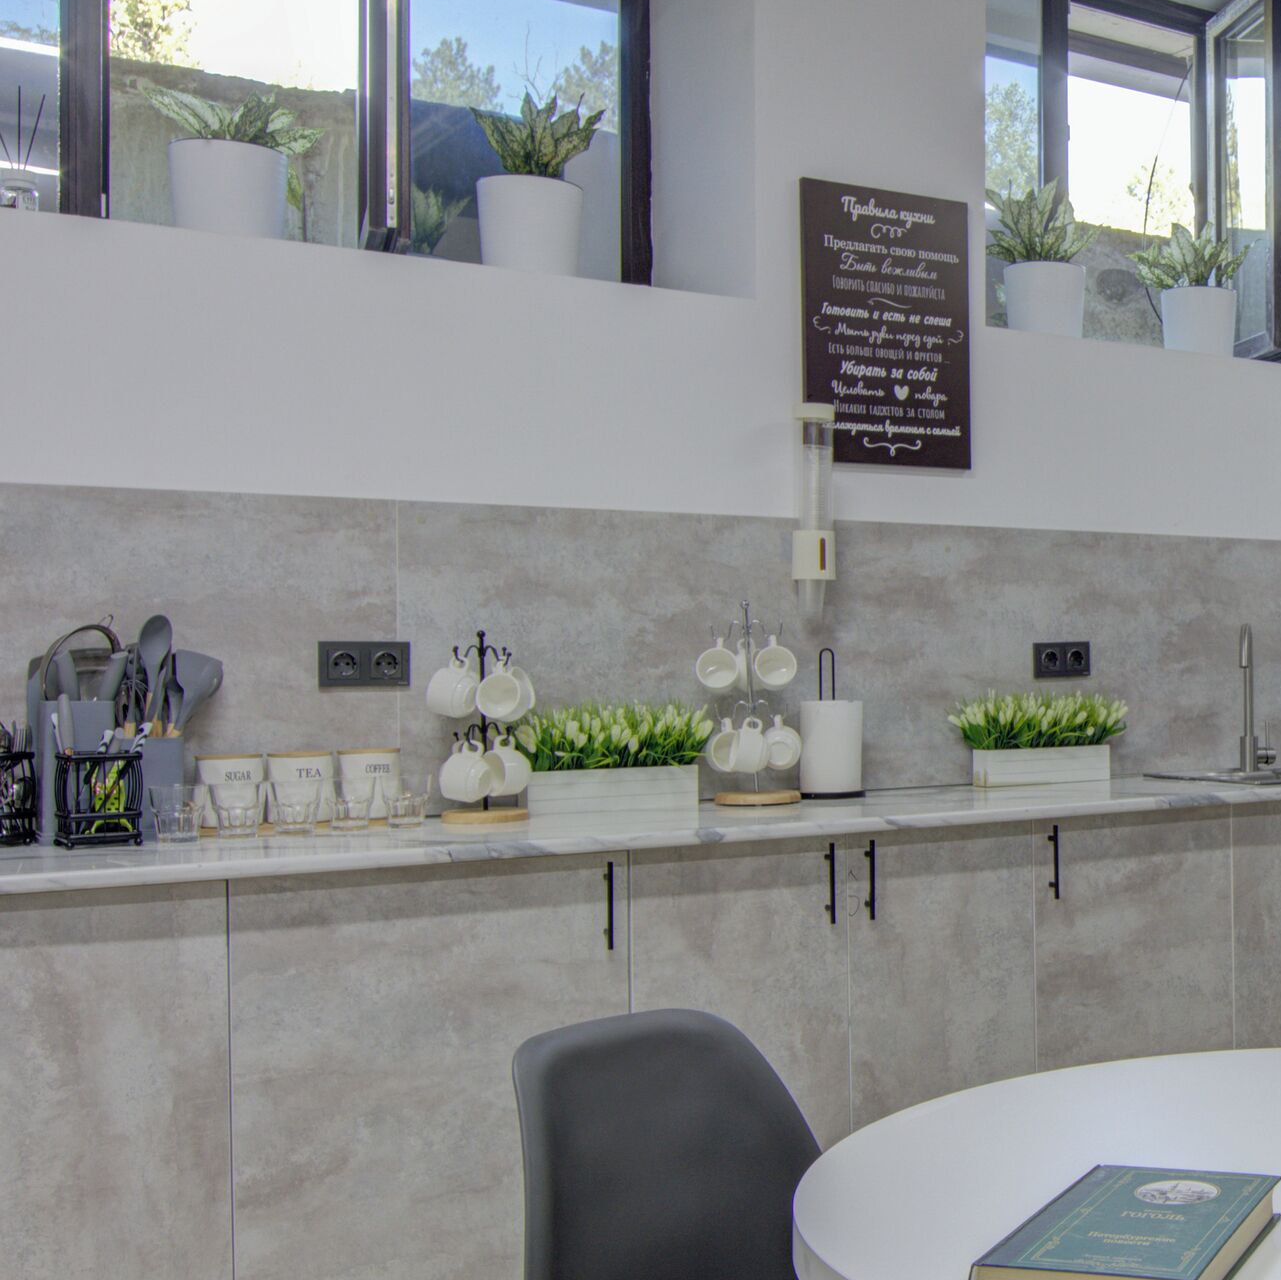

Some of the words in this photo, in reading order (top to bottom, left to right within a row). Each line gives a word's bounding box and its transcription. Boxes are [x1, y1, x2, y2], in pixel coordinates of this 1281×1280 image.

[841, 195, 898, 221] Правила
[900, 208, 935, 228] кухни
[824, 234, 888, 254] Предлагать
[890, 245, 916, 258] свою
[918, 250, 959, 264] помощь
[840, 252, 877, 272] Быть
[881, 258, 937, 280] вежливым
[866, 279, 895, 295] СПАСИБО
[896, 283, 902, 295] И
[821, 302, 869, 319] Готовить
[873, 310, 880, 320] и
[882, 311, 905, 322] есть
[909, 314, 921, 324] не
[924, 315, 952, 327] спеша
[835, 322, 869, 337] Мыть
[895, 333, 921, 348] перед
[923, 335, 944, 349] едой
[846, 344, 873, 357] БОЛЬШЕ
[906, 349, 913, 360] И
[840, 360, 886, 379] Убирать
[890, 368, 902, 379] за
[907, 367, 938, 382] собой
[831, 379, 885, 397] Целовать
[915, 386, 948, 407] повара
[906, 407, 915, 417] ЗА
[884, 419, 926, 438] временем
[225, 770, 251, 782] SUGAR
[296, 768, 321, 779] TEA
[365, 763, 390, 774] COFFEE
